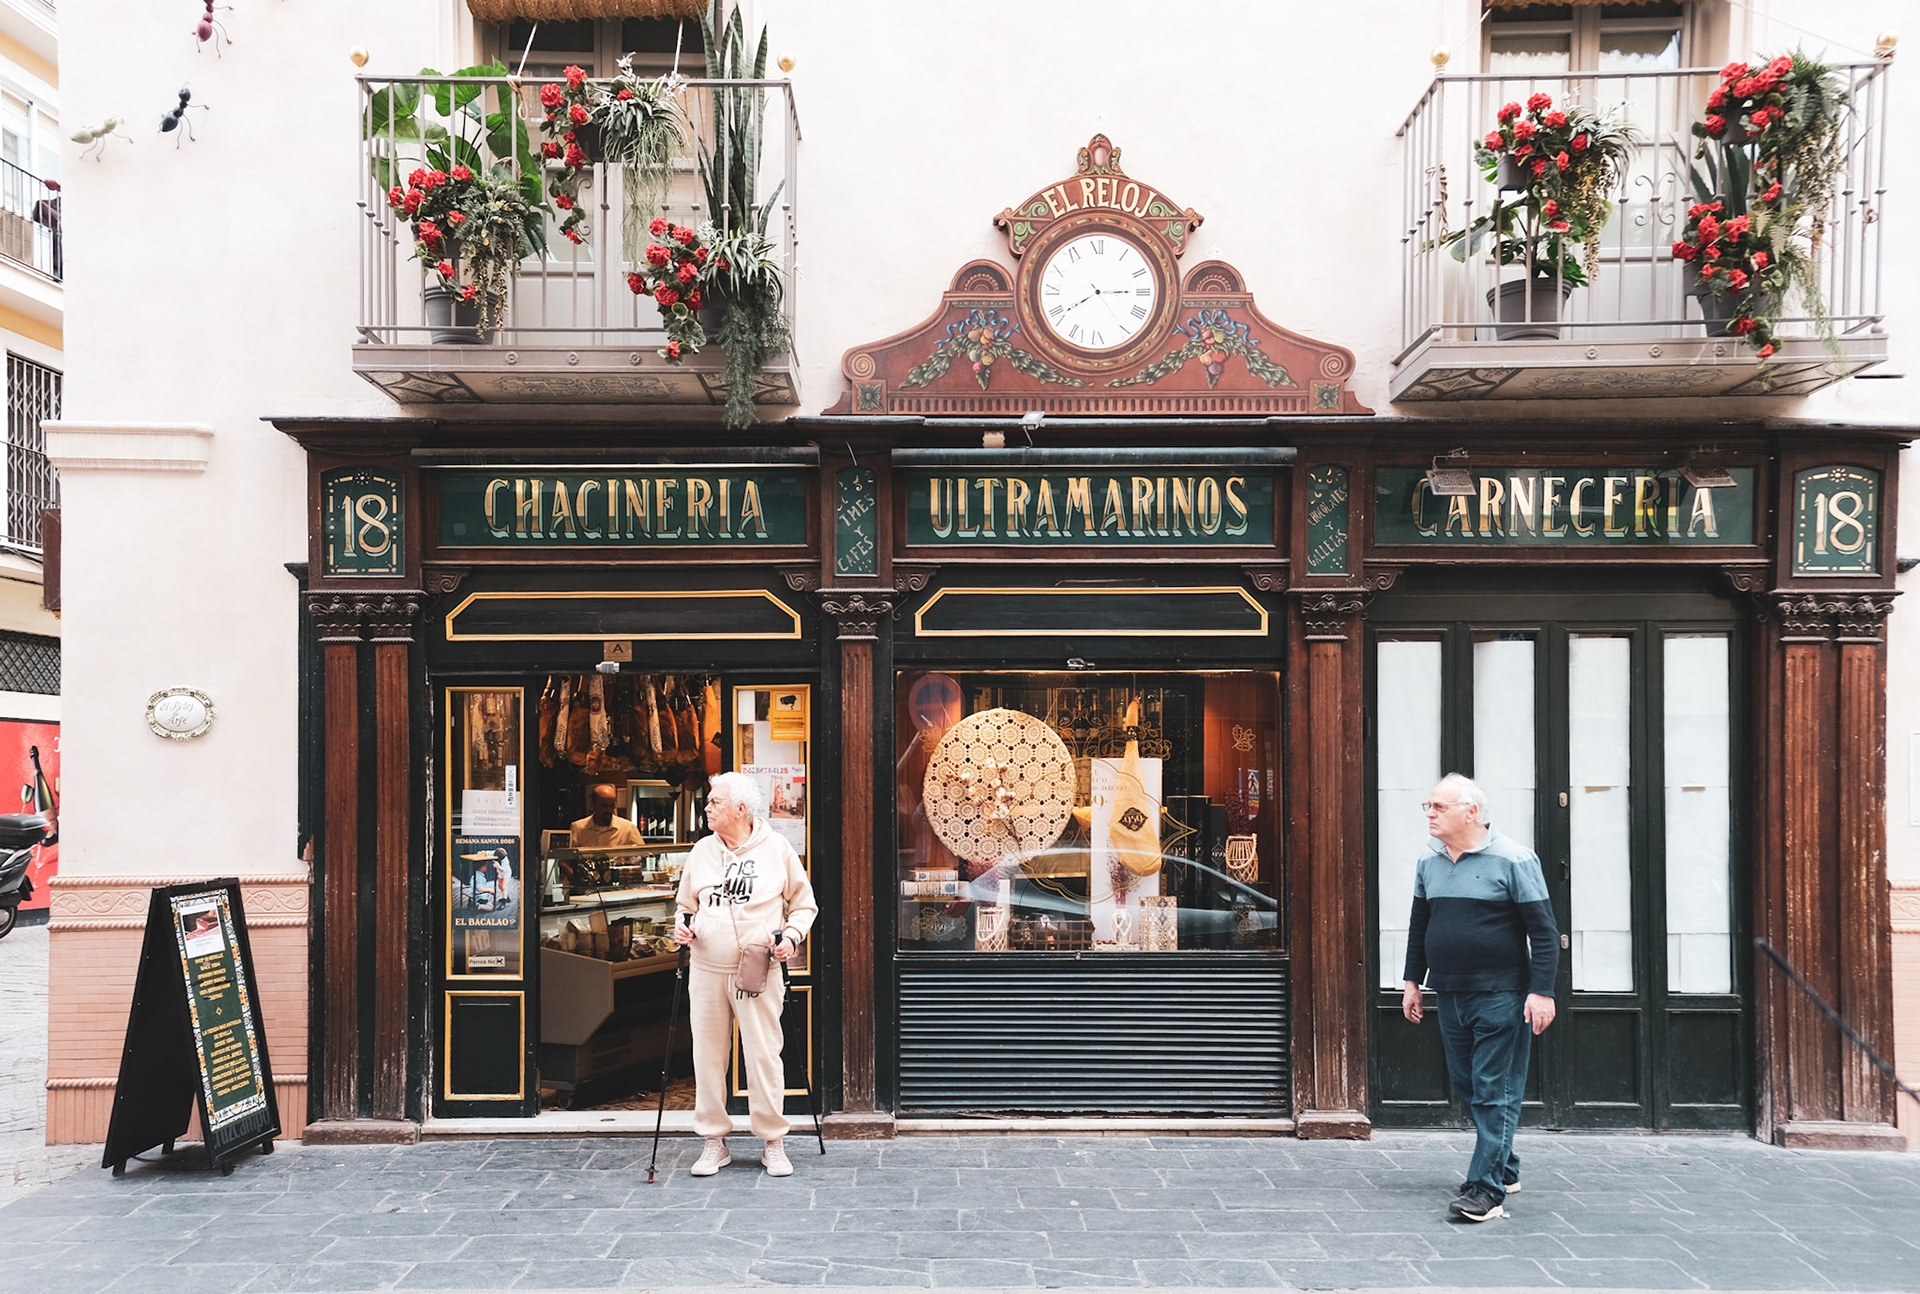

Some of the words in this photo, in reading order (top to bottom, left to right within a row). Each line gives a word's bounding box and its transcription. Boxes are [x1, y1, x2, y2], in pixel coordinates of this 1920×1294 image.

[1041, 184, 1079, 219] EL
[1079, 177, 1157, 218] RELOJ
[341, 494, 391, 557] 18
[484, 478, 769, 539] CHACINERIA
[839, 493, 875, 527] THES
[929, 476, 1249, 538] ULTRAMARINOS
[1324, 520, 1334, 531] Y
[1411, 476, 1720, 538] CARNECERIA
[1813, 491, 1866, 556] 18
[854, 525, 864, 537] Y
[1307, 528, 1348, 568] GALLETAS
[837, 535, 874, 572] CAFES
[612, 643, 624, 654] A
[455, 918, 467, 926] EL
[468, 918, 509, 926] BACALAO
